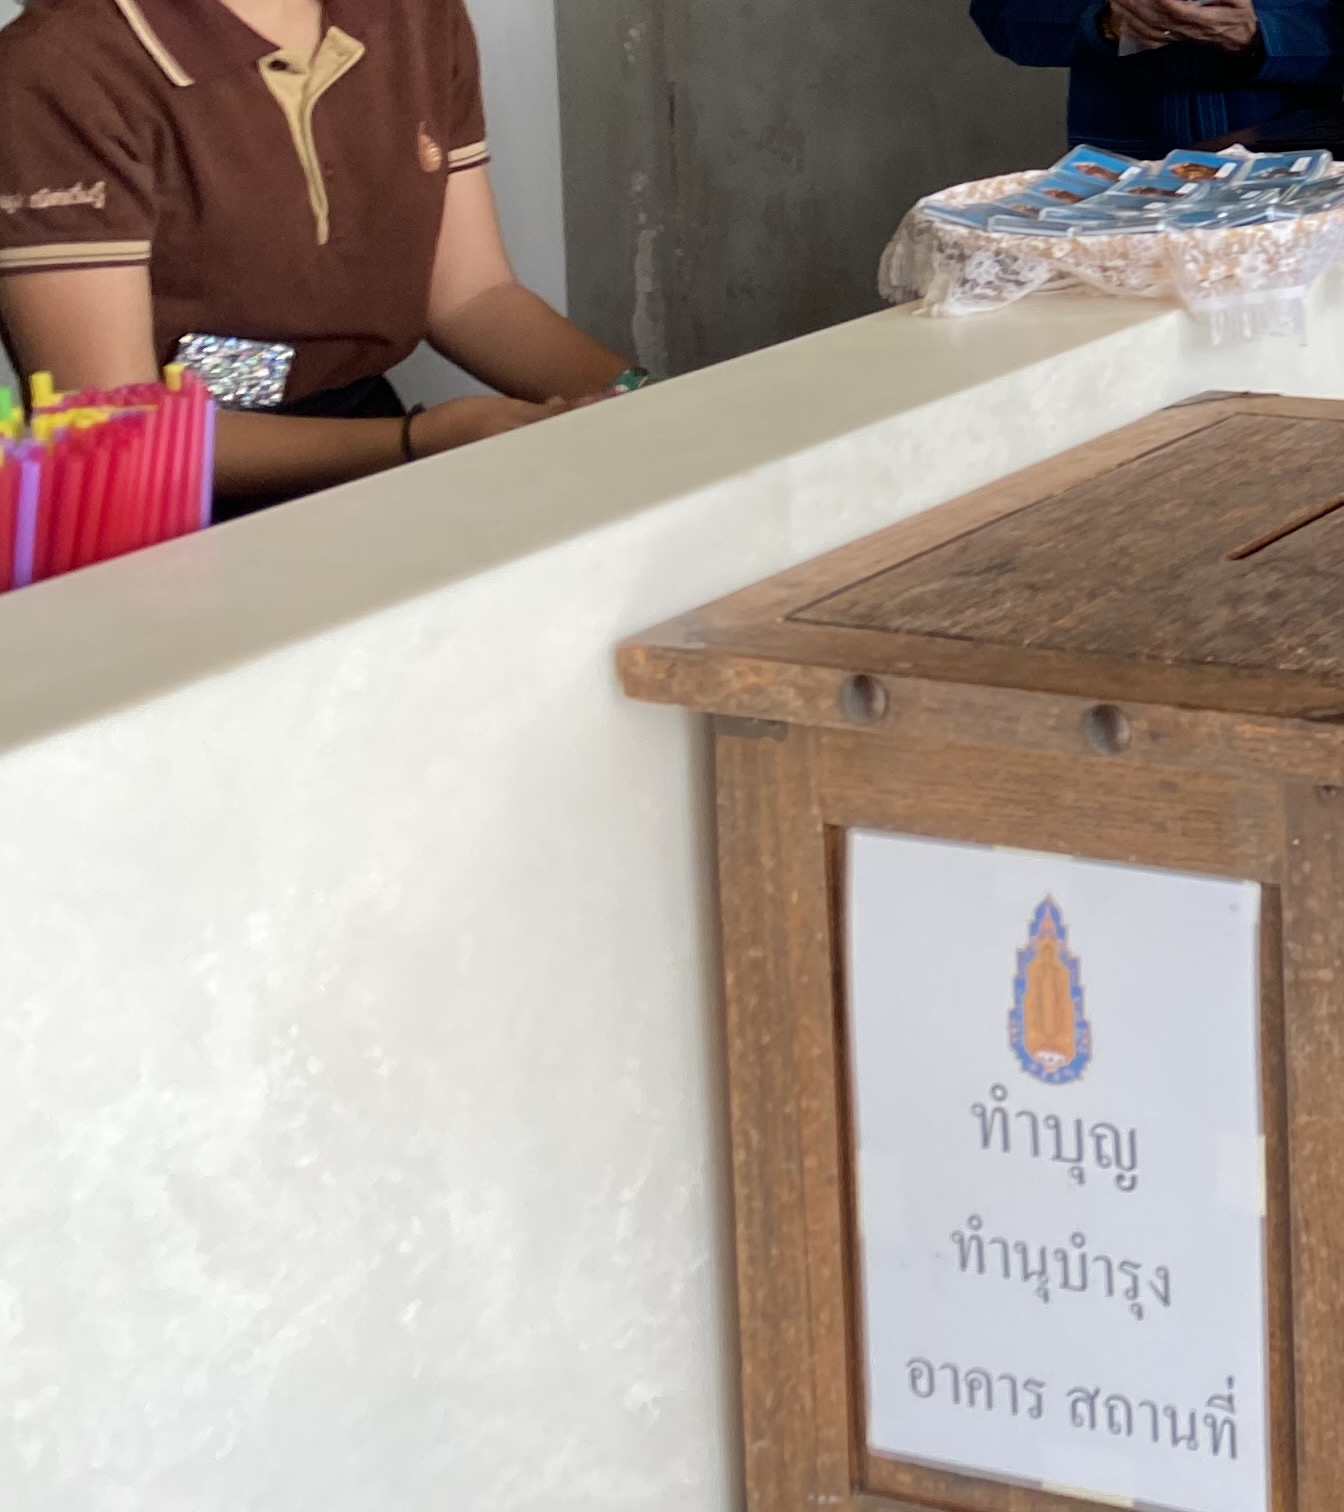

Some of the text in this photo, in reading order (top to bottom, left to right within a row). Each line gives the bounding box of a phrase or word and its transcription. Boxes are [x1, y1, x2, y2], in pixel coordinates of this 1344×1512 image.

[970, 1082, 1139, 1192] ทำบุญ
[950, 1213, 1172, 1321] ทำนุบำรุง
[905, 1355, 1239, 1461] อาคาร สถานที่
